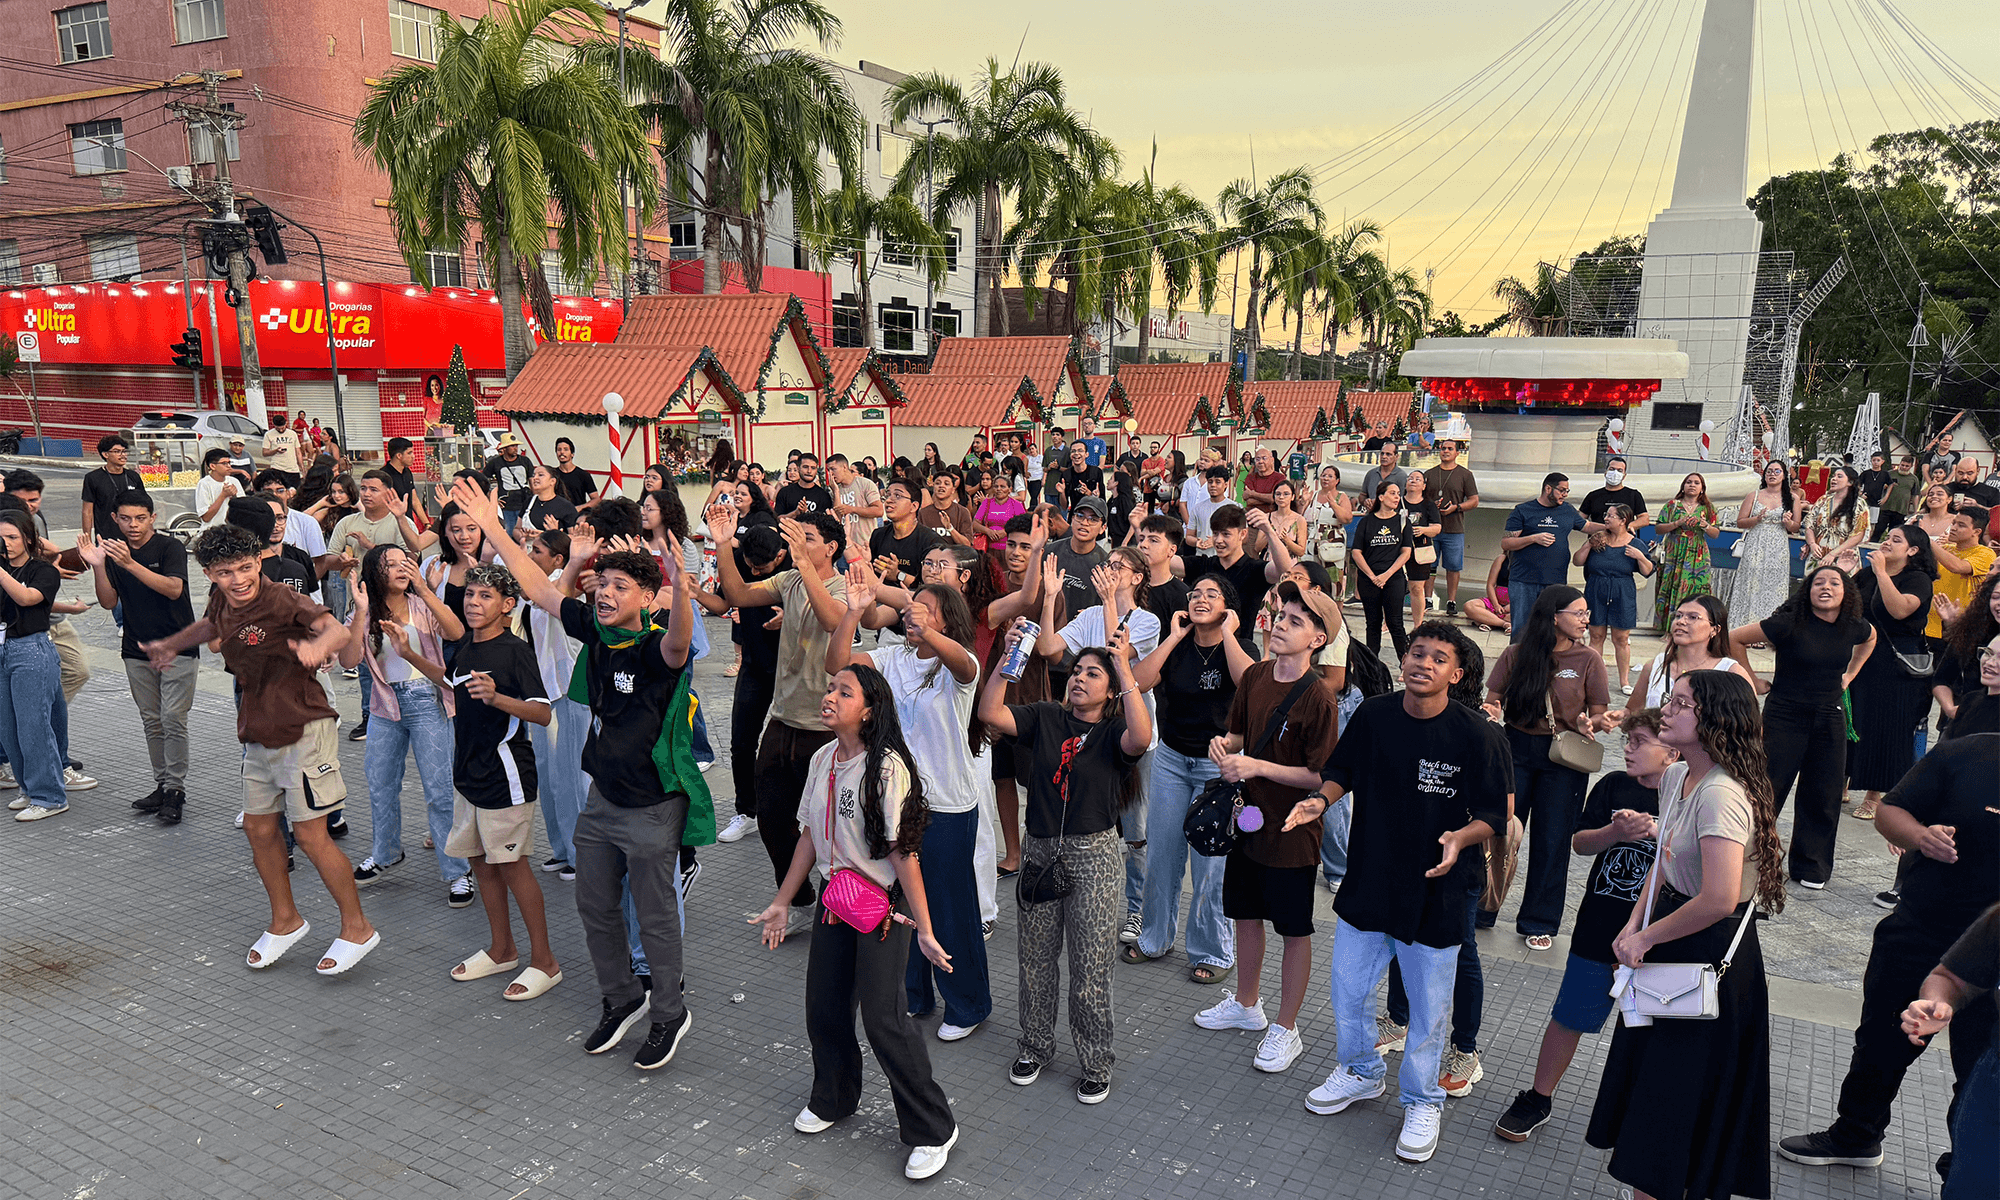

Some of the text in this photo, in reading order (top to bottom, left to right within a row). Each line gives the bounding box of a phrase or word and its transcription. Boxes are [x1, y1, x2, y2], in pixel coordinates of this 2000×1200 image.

[53, 301, 75, 311] Drogarias
[329, 302, 373, 313] Drogarias
[37, 309, 76, 331] Ultra
[289, 308, 371, 334] Ultra
[565, 312, 593, 322] Drogarias
[24, 336, 32, 346] E
[56, 333, 80, 345] Popular
[1292, 459, 1300, 468] 12
[614, 671, 635, 682] HOLY
[1440, 763, 1461, 774] Days
[1417, 784, 1457, 798] ordinary
